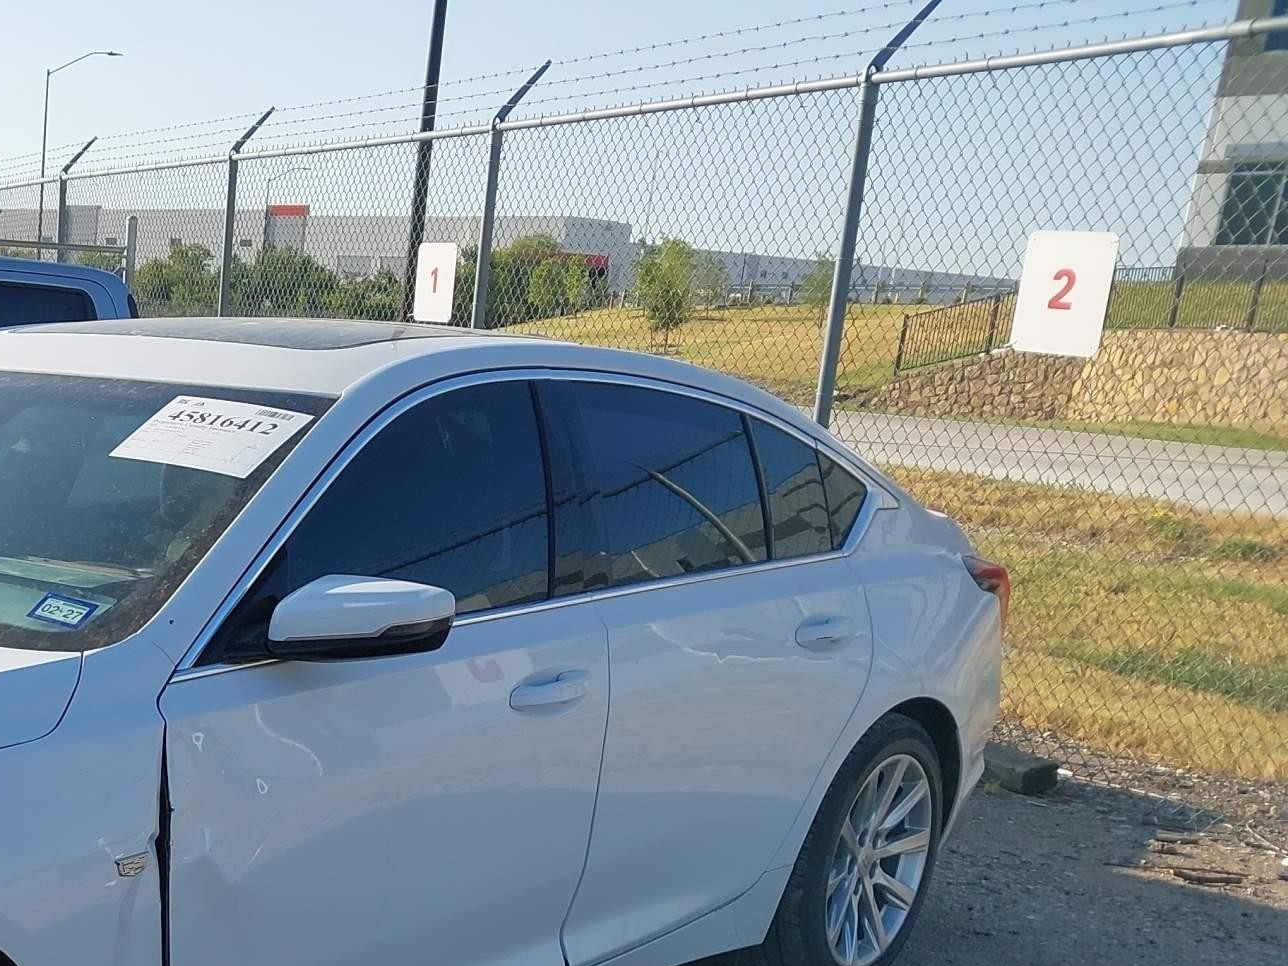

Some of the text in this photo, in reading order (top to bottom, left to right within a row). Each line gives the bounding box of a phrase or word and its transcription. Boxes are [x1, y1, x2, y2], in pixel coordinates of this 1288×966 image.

[431, 266, 439, 294] 1
[1047, 268, 1077, 311] 2
[167, 409, 279, 435] 45816412
[41, 603, 83, 620] 02 27
